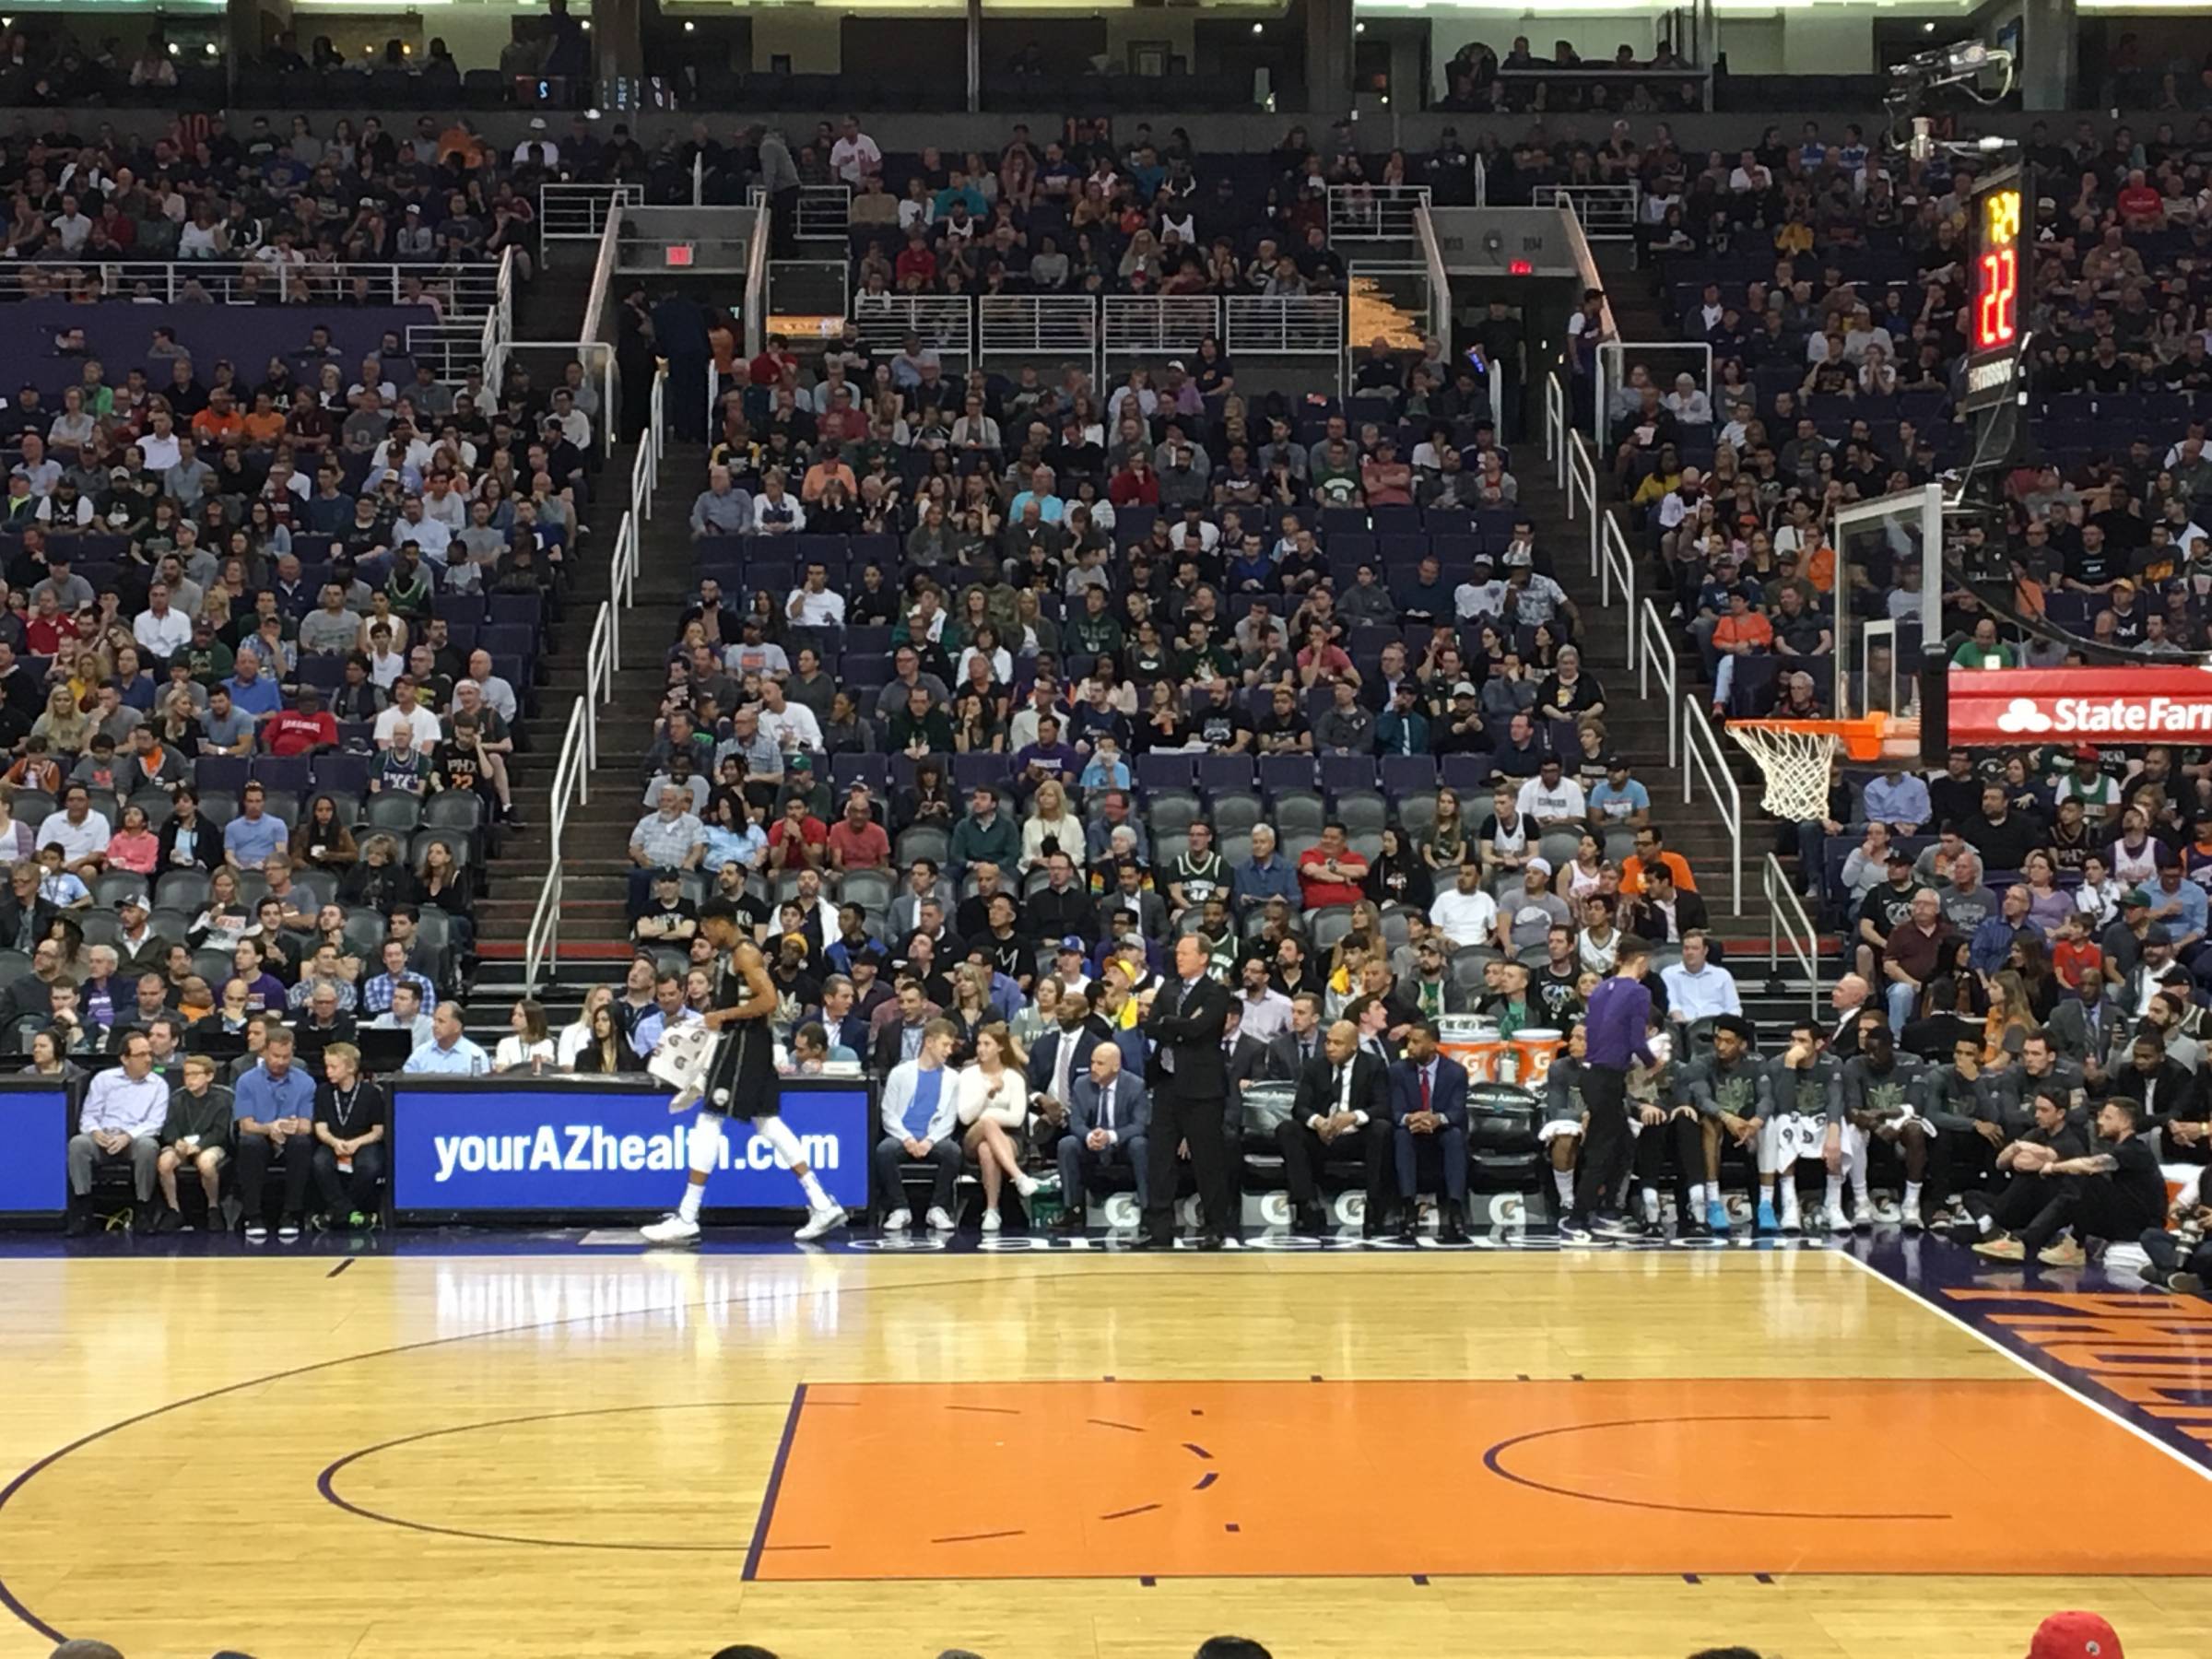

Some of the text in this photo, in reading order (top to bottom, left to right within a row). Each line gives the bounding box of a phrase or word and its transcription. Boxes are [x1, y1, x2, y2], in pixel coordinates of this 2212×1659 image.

[1983, 249, 2014, 345] 22
[2054, 699, 2147, 731] State
[447, 759, 479, 773] PHX
[1463, 1053, 1479, 1073] G
[1534, 1052, 1551, 1070] G
[434, 1124, 840, 1182] yourAZheal.cm
[1261, 1190, 1295, 1226] G
[1488, 1192, 1526, 1226] G
